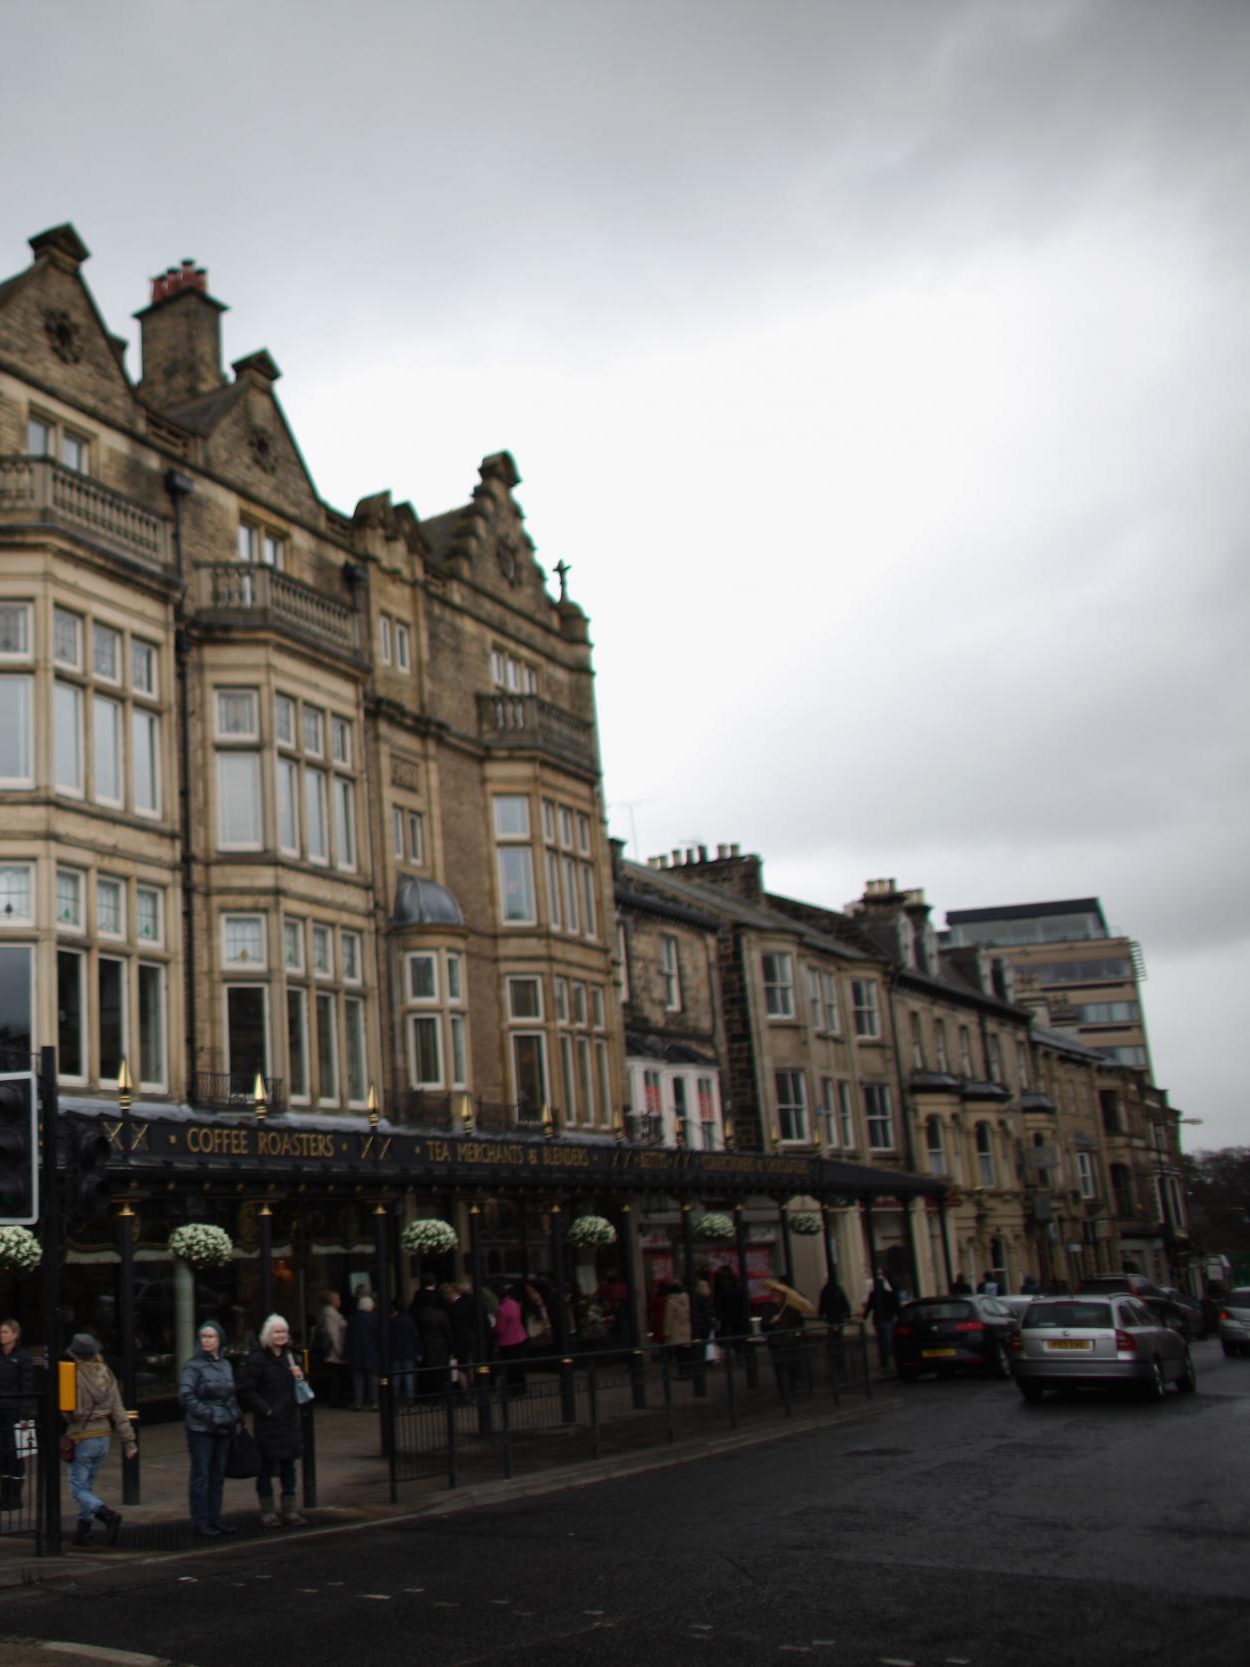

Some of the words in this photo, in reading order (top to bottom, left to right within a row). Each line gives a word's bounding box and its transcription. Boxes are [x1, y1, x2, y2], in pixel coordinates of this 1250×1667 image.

[185, 1126, 249, 1154] COFFEE
[257, 1130, 334, 1158] ROASTERS
[426, 1139, 451, 1163] TEA
[456, 1141, 525, 1165] MERCHANTS
[541, 1145, 589, 1167] BLENDERS
